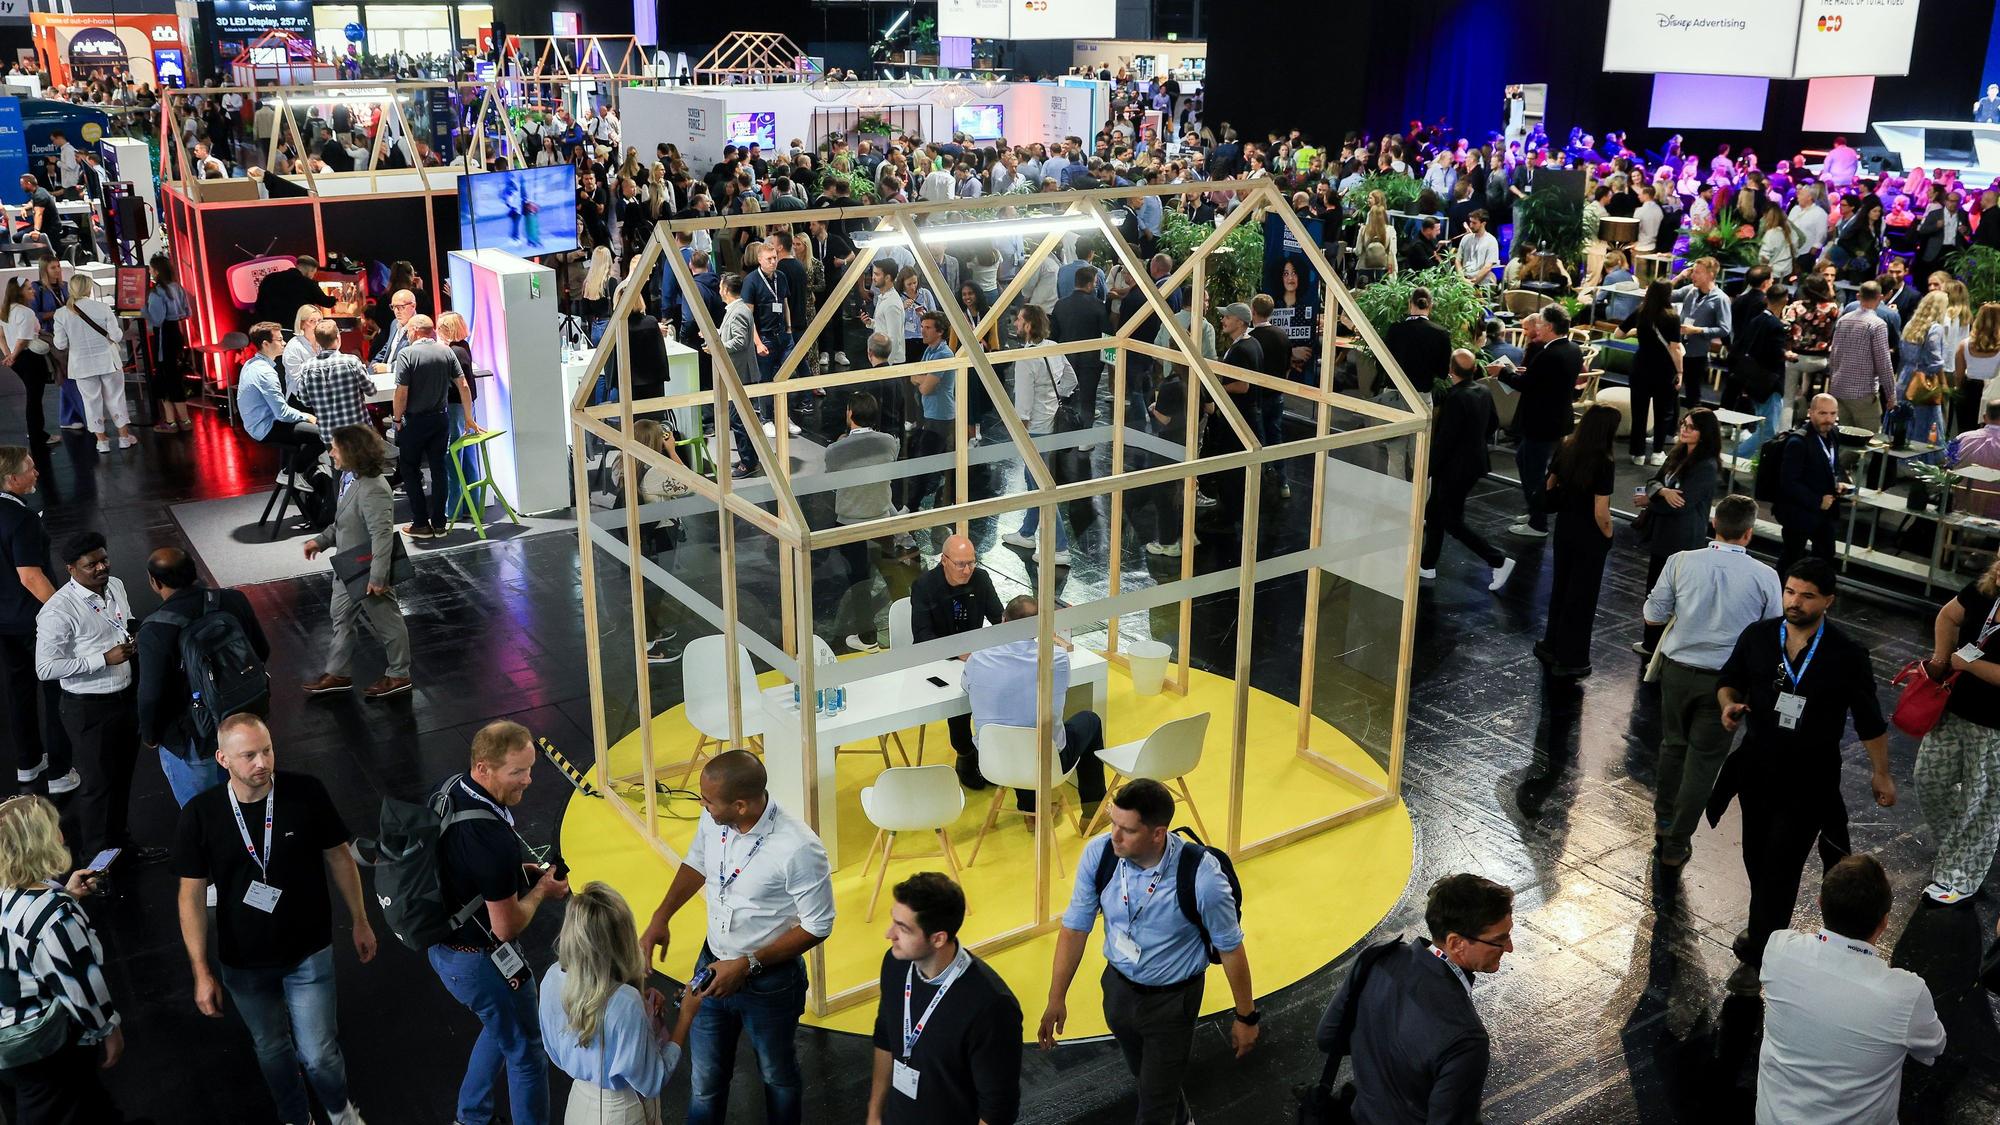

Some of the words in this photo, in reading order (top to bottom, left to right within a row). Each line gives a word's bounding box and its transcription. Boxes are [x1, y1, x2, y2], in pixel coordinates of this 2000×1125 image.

[216, 17, 229, 26] 3D
[230, 17, 246, 26] LED
[247, 17, 279, 27] Display,
[280, 17, 295, 26] 257
[1656, 13, 1692, 31] Disney
[1693, 18, 1746, 30] Advertising
[688, 118, 701, 130] FORCE
[1286, 327, 1310, 337] LEDGE
